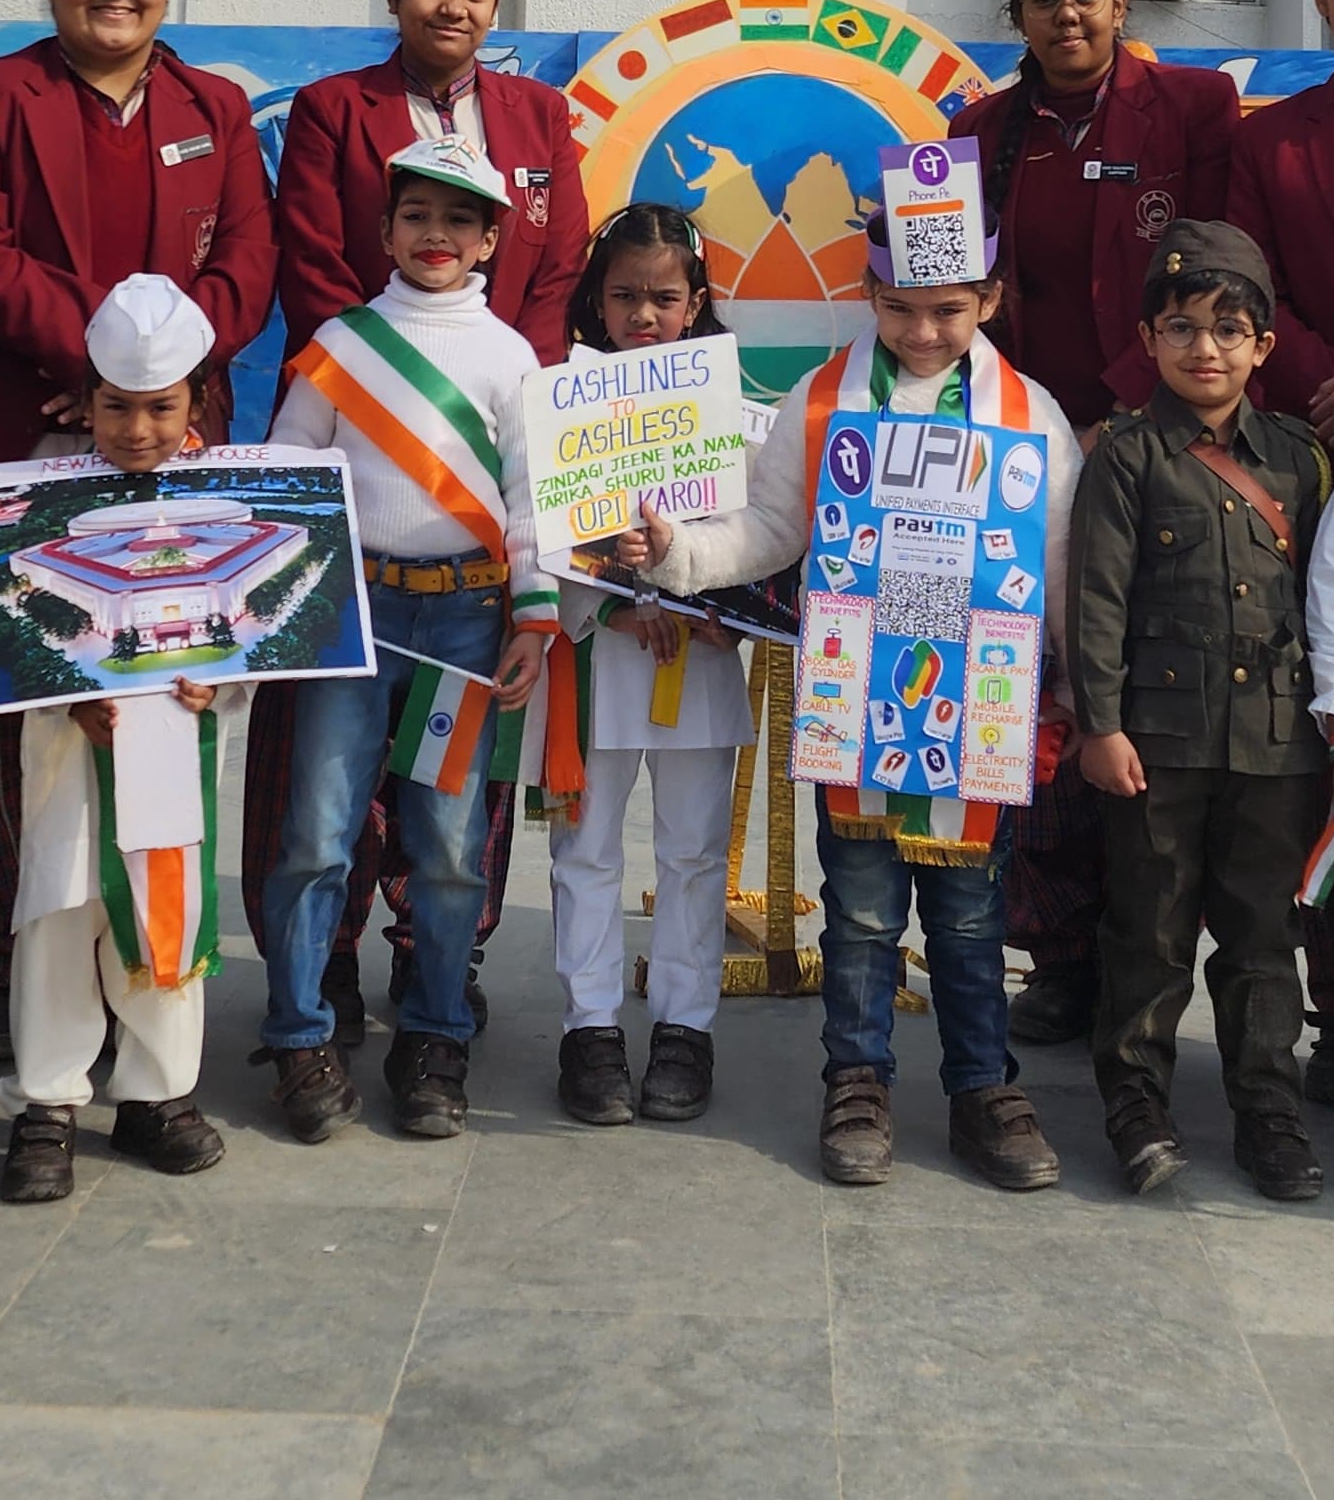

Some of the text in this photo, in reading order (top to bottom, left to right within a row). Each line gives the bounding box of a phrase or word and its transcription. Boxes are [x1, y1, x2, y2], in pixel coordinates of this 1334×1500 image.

[909, 190, 936, 202] Phone
[553, 349, 710, 410] CASHLINES
[608, 398, 635, 419] TO
[558, 406, 695, 463] CASHLESS
[42, 457, 86, 472] NEW
[208, 447, 269, 461] HOUSE
[536, 433, 746, 496] ZINDAGI JEENE KA NAYA
[536, 485, 593, 513] TARIKA
[605, 466, 665, 494] SHURU
[577, 495, 623, 532] UPI
[819, 606, 861, 618] BENEFITS
[978, 614, 1033, 631] TECHNOLOGY
[985, 629, 1026, 641] BENEFITS
[806, 657, 857, 670] BOOK GAS
[970, 663, 997, 675] SCAN
[1010, 666, 1030, 676] PAY
[810, 667, 856, 680] CYLINDER
[801, 700, 851, 715] CABLE TV
[973, 702, 1016, 714] MOBILE
[803, 744, 840, 758] FLIGHT
[798, 756, 842, 772] BOOKING
[964, 755, 1025, 768] ELECTRICITY
[976, 766, 1004, 779] BILLS
[964, 779, 1023, 795] PAYMENTS
